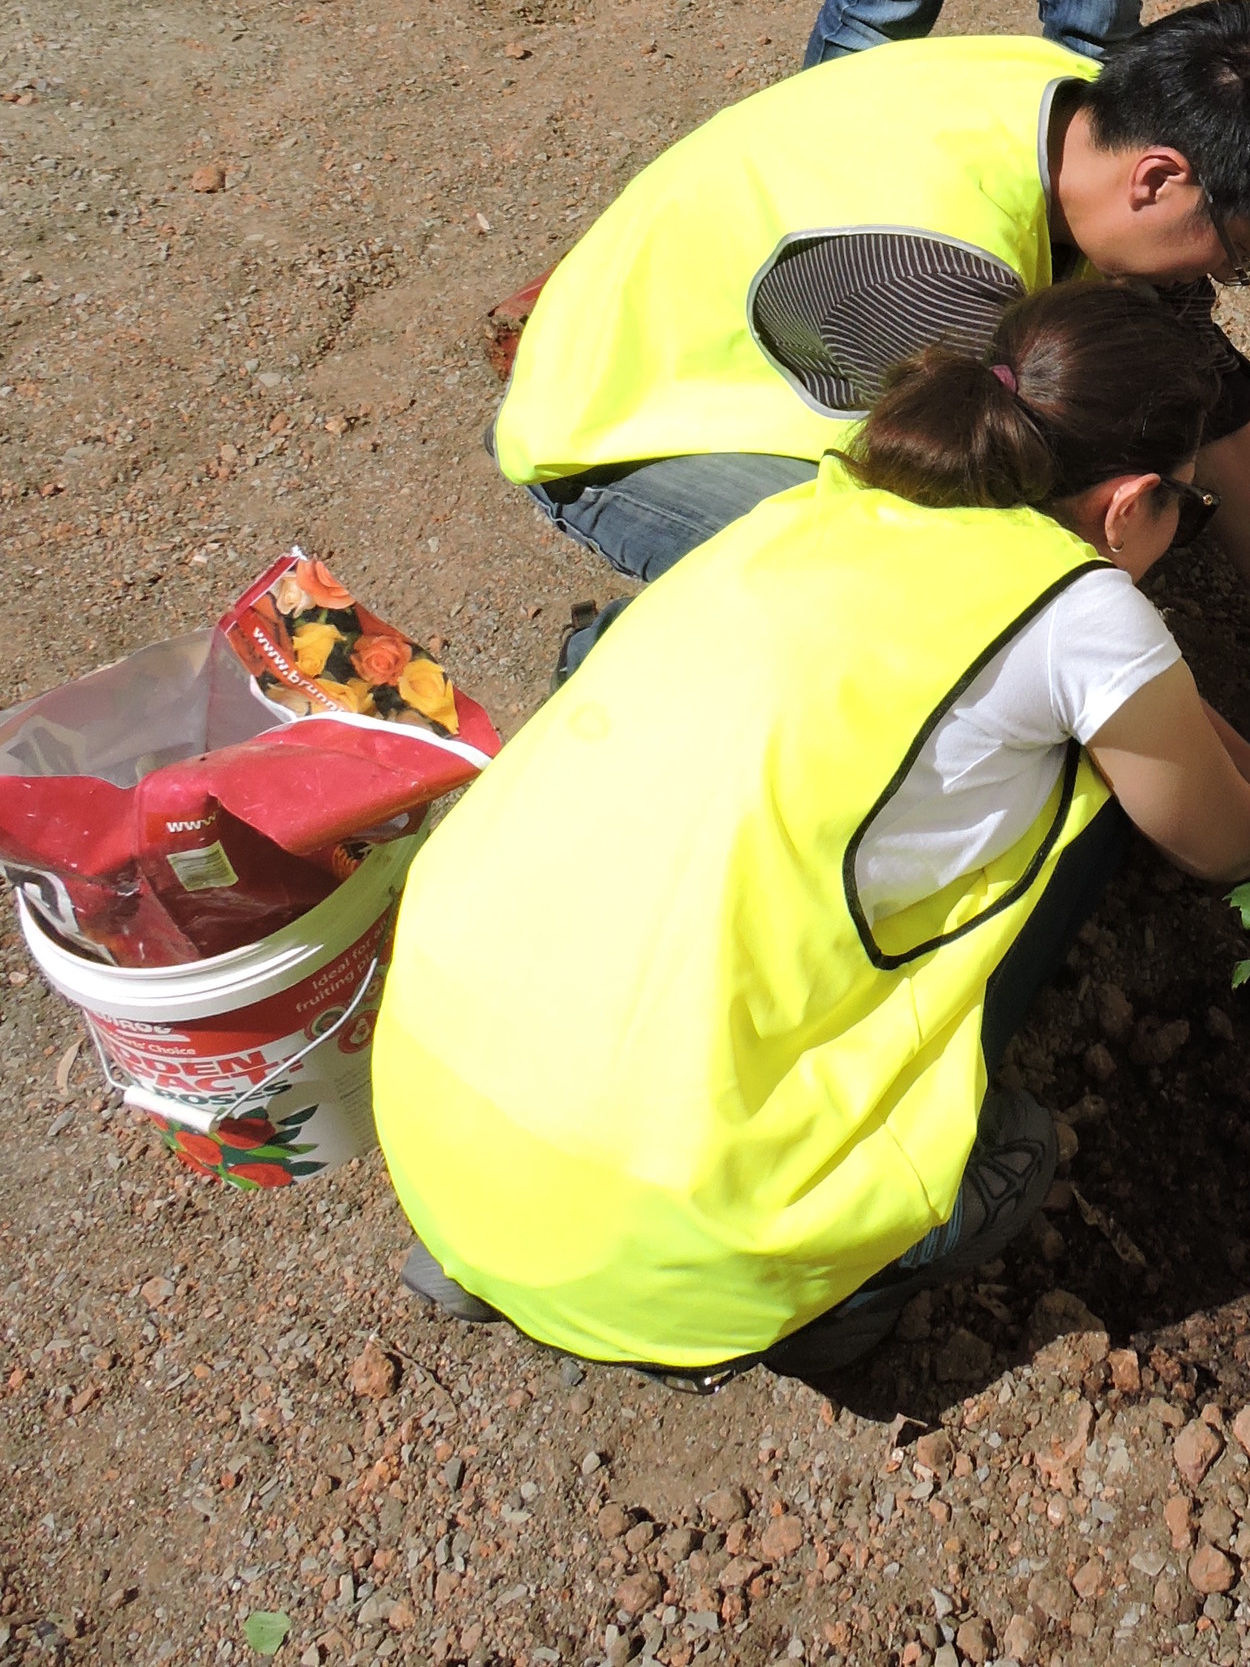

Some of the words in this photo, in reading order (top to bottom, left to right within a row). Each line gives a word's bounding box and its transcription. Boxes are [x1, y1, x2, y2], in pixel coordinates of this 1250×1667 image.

[312, 958, 350, 990] Ideal
[351, 939, 371, 960] for
[295, 970, 356, 1013] fruiting
[148, 1043, 196, 1055] Choice
